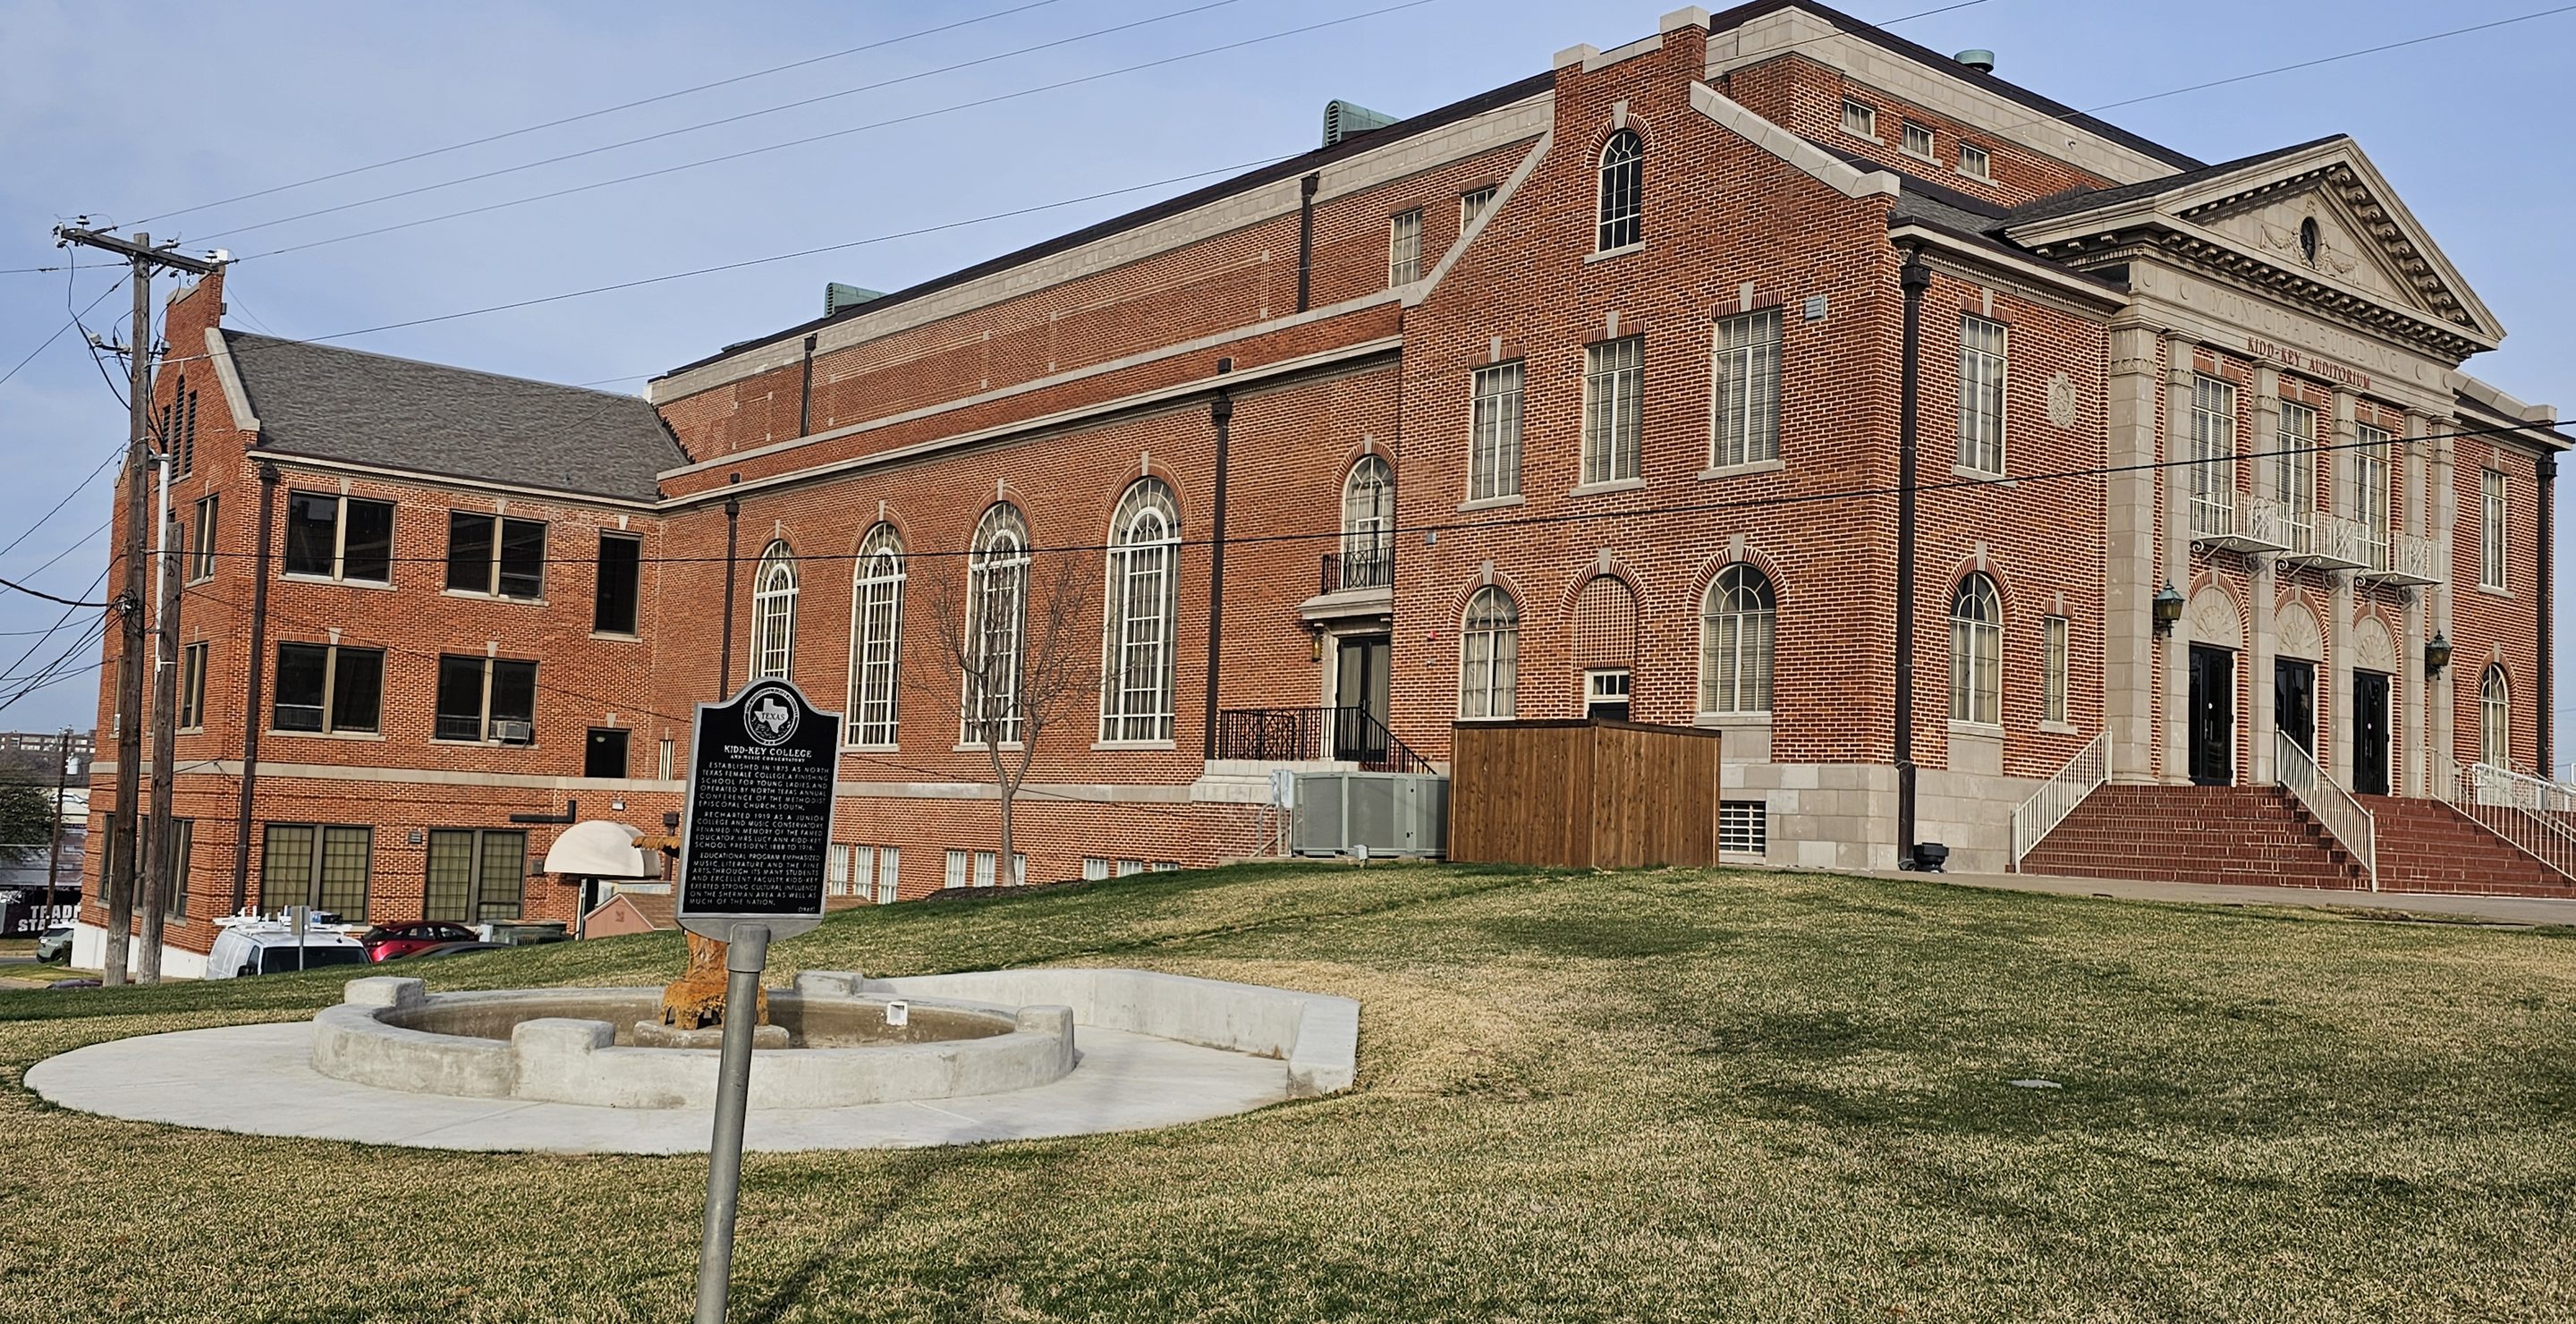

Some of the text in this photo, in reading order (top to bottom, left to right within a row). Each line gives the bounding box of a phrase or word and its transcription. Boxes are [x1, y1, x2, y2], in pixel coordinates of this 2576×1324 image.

[2211, 289, 2398, 373] MUNICIPAL BUILDING
[2247, 336, 2370, 390] KIDD-KEY AUDITORIUM
[761, 712, 785, 721] TEXAS
[724, 744, 812, 758] KIDD-KEY COLLEGE
[708, 761, 759, 771] ESTABLISHED
[724, 770, 751, 778] FEMALE
[701, 777, 735, 785] SCHOOL
[757, 779, 783, 787] YOUNG
[700, 785, 738, 793] OPERATED
[699, 793, 752, 802] CONFERENCE
[699, 800, 740, 809] EPISCOPAL
[697, 818, 728, 826] COLLEGE
[695, 841, 726, 849] SCHOOL
